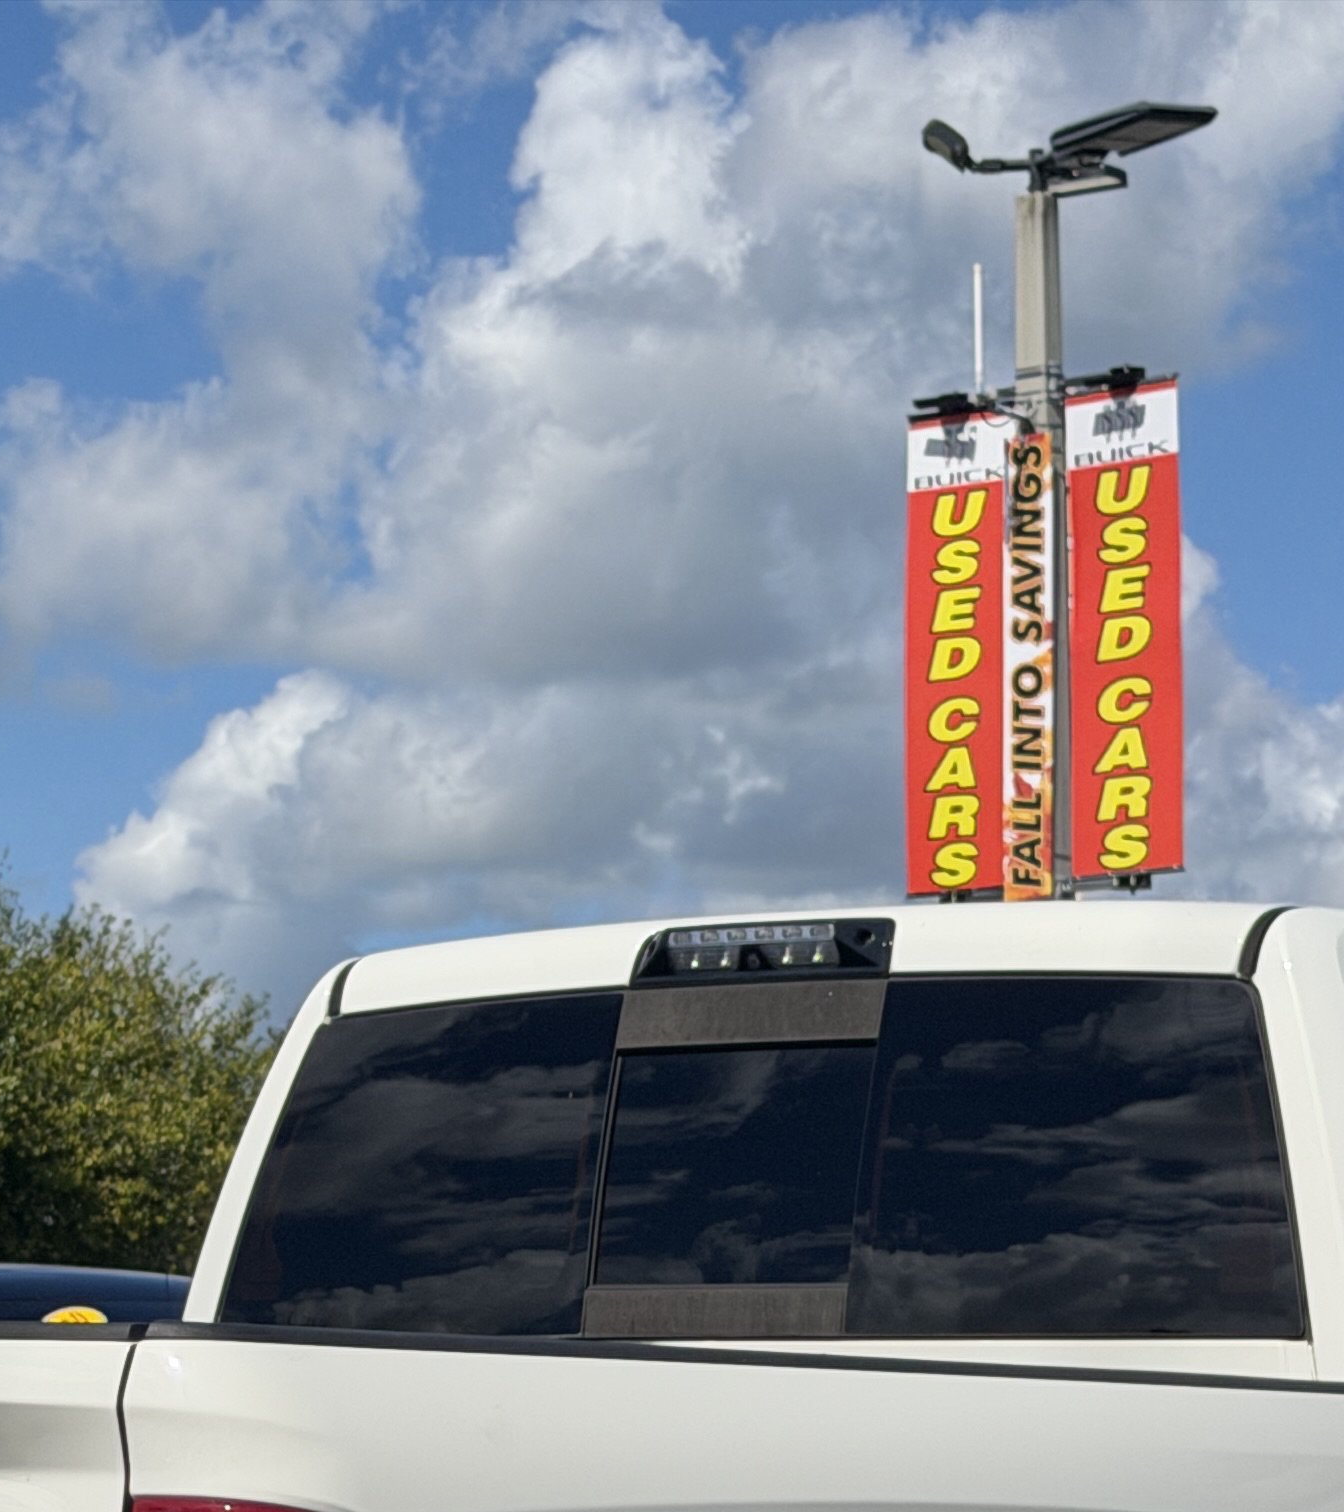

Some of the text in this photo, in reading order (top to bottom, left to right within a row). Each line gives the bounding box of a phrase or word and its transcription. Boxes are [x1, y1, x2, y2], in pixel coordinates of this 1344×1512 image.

[913, 467, 1006, 490] BUICK
[1073, 439, 1171, 467] BUICK
[923, 488, 989, 889] USED CARS
[1010, 444, 1044, 890] FALL INTO SAVINGS
[1092, 464, 1153, 872] USED CARS
